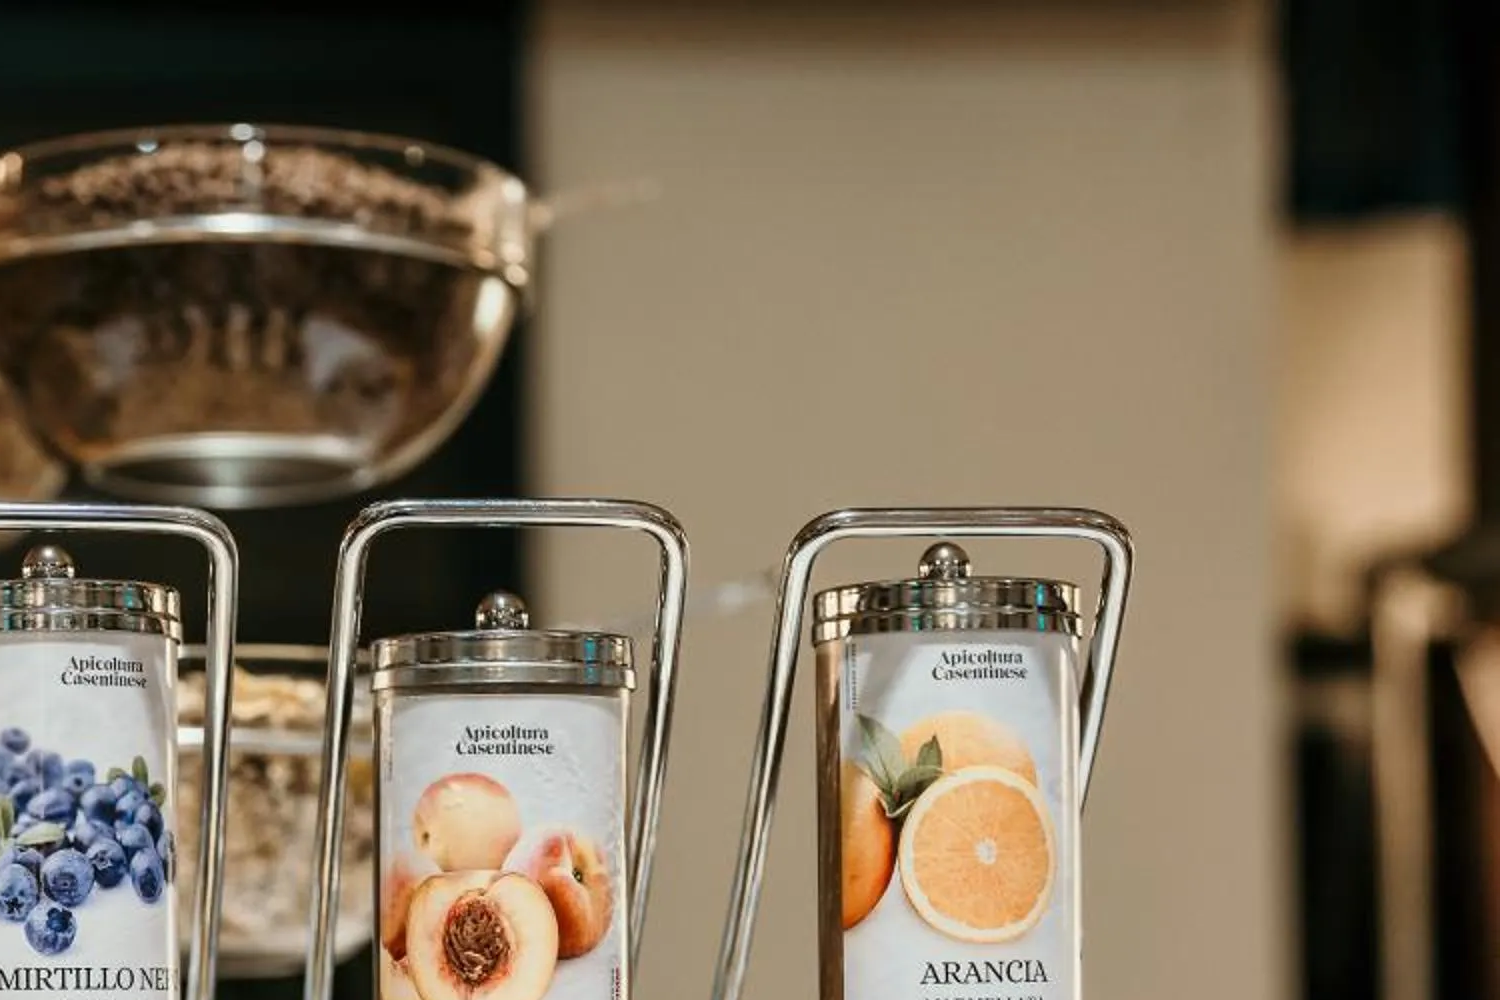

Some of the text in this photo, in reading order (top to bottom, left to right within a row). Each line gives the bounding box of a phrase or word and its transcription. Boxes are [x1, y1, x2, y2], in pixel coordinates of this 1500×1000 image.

[68, 656, 143, 673] Apicoltura
[939, 650, 1023, 666] Apicoltura
[60, 671, 147, 689] Casentinese
[932, 665, 1029, 681] Casentinese
[463, 725, 548, 740] Apicoltura
[455, 740, 555, 756] Casentinese
[920, 959, 1049, 985] ARANCIA
